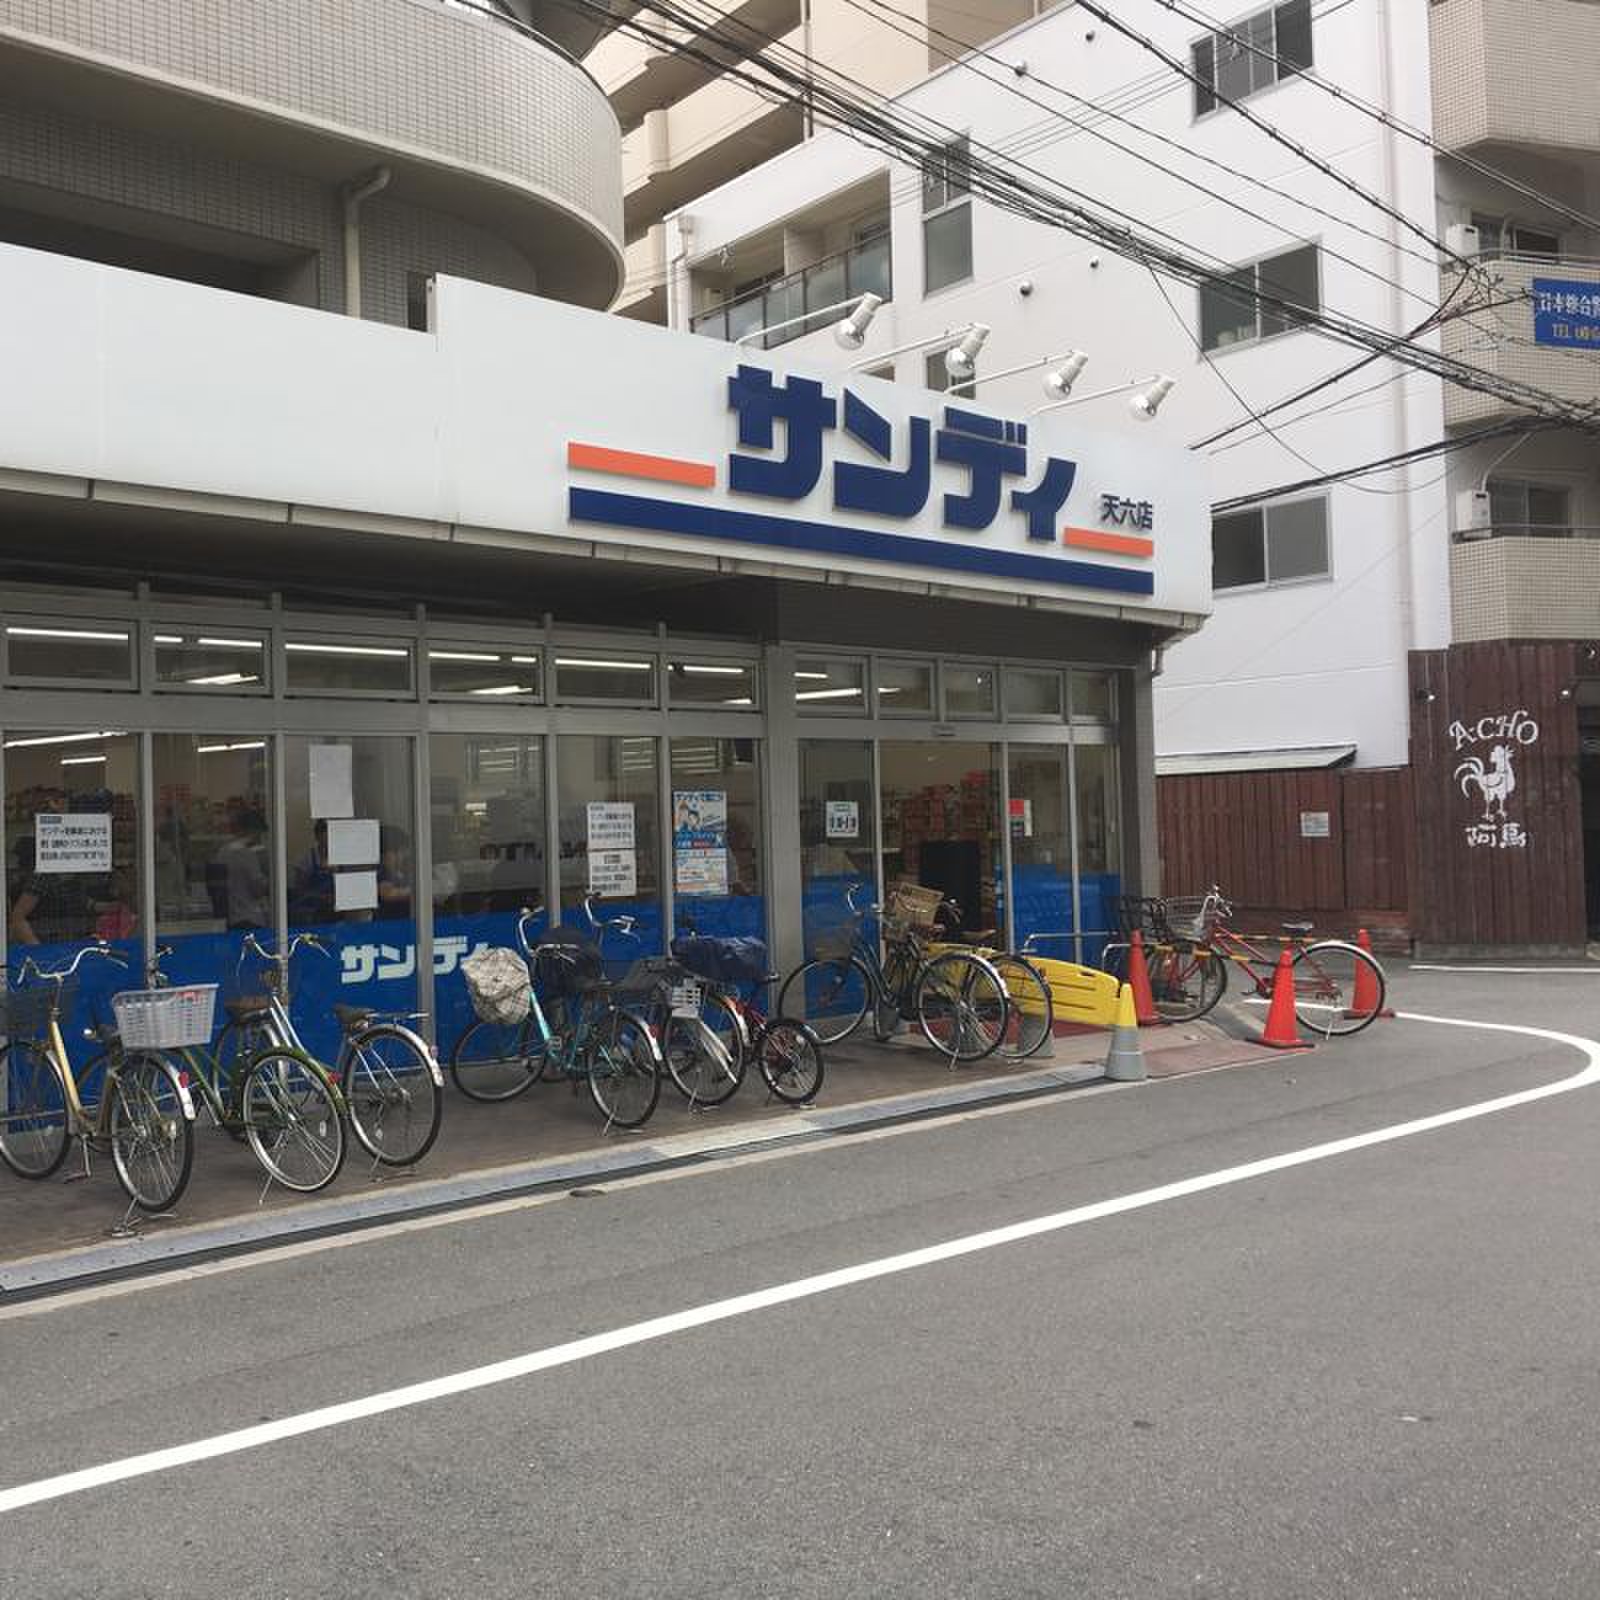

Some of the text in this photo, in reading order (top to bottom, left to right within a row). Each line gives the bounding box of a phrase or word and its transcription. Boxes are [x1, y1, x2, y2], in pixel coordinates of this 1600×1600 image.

[727, 363, 1077, 542] サンディ
[1101, 493, 1153, 531] 天六店
